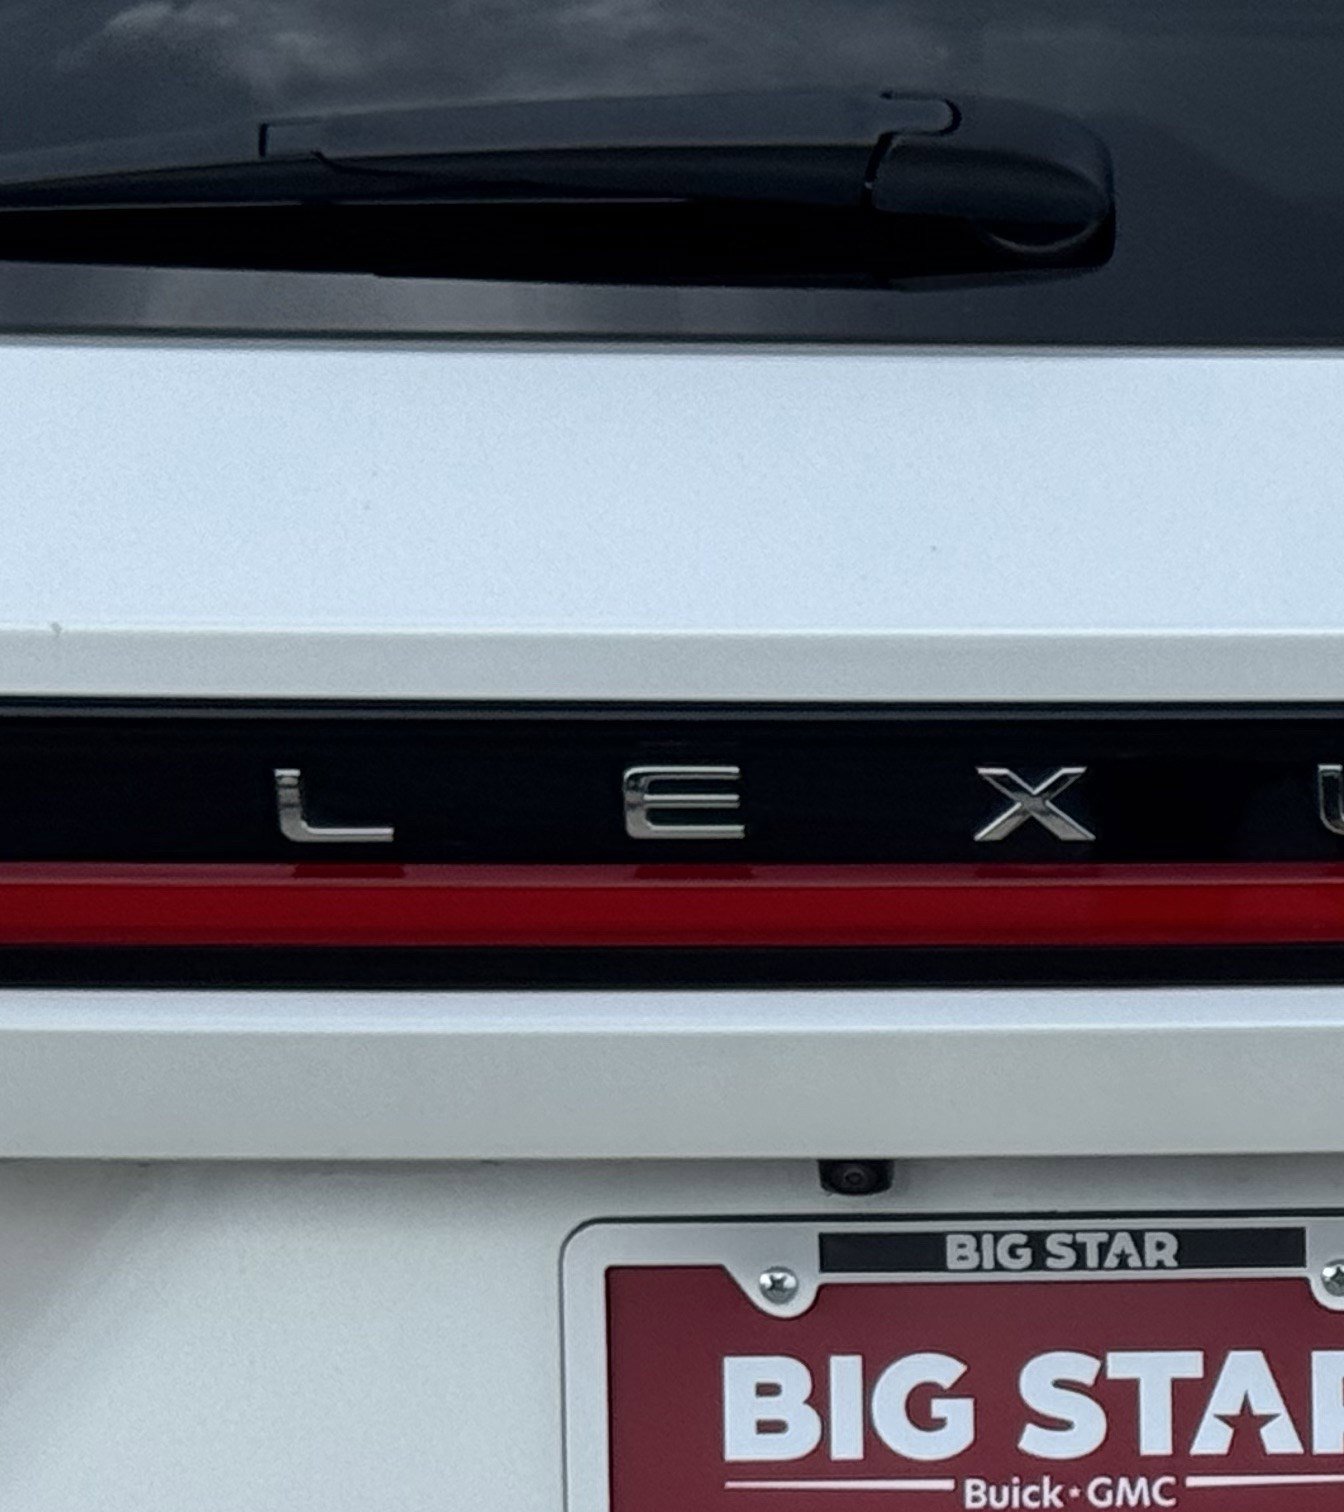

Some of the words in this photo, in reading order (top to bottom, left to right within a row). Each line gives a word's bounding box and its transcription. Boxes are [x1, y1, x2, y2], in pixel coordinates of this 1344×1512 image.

[946, 1232, 1029, 1270] BIG
[1046, 1230, 1178, 1269] STAR
[722, 1352, 975, 1462] BIG
[964, 1477, 1064, 1510] Buick
[1086, 1475, 1177, 1508] GMC
